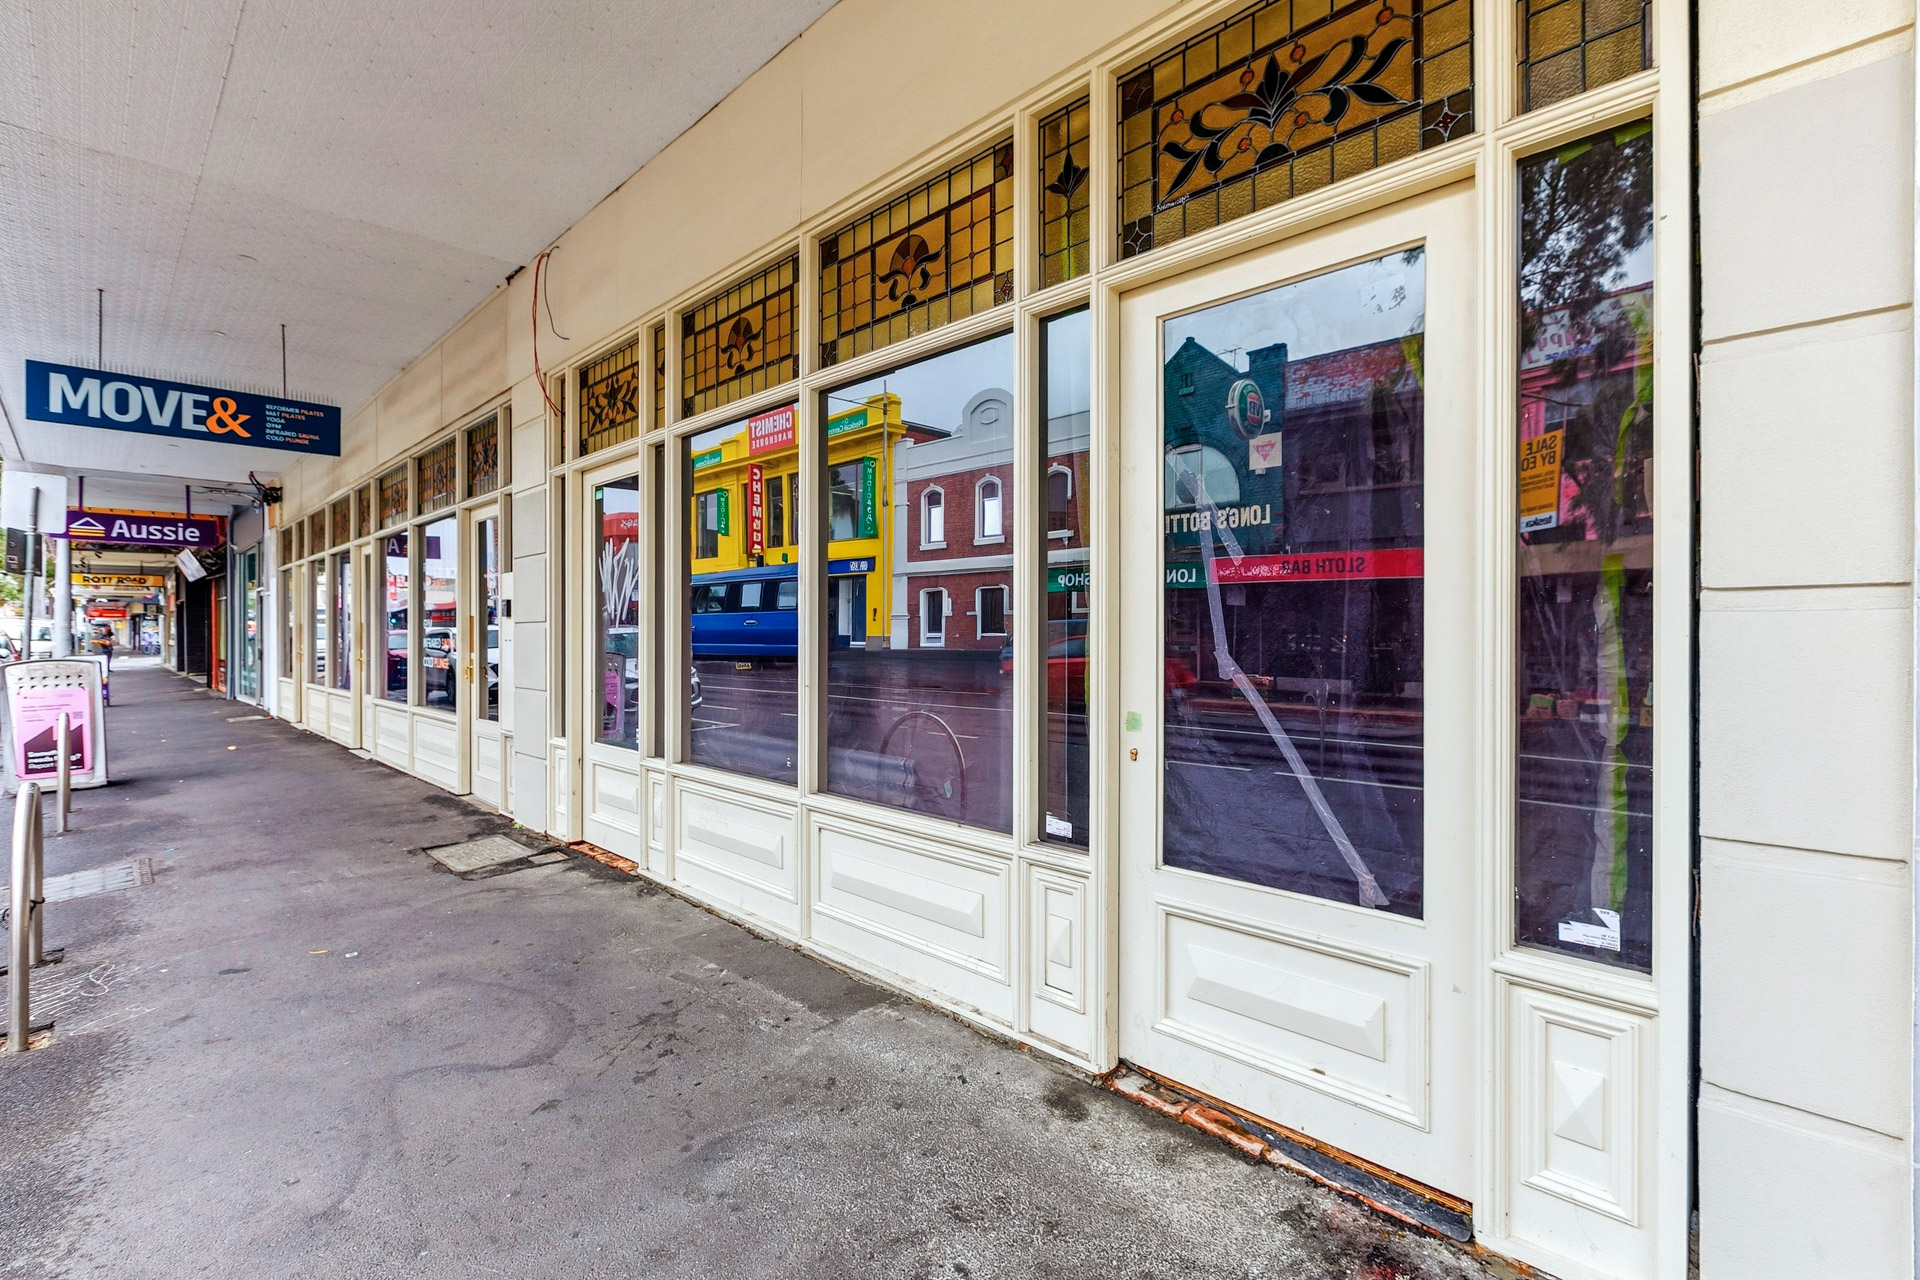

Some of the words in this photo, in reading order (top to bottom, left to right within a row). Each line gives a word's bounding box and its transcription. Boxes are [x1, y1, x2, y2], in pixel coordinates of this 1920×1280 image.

[49, 371, 252, 438] MOVE&
[281, 412, 306, 421] PILATES
[300, 409, 325, 418] PILATES
[266, 416, 286, 424] YOGA
[265, 428, 297, 437] INFRARED
[265, 434, 285, 442] COLD
[110, 519, 200, 542] Aussie
[117, 576, 147, 585] ROAD
